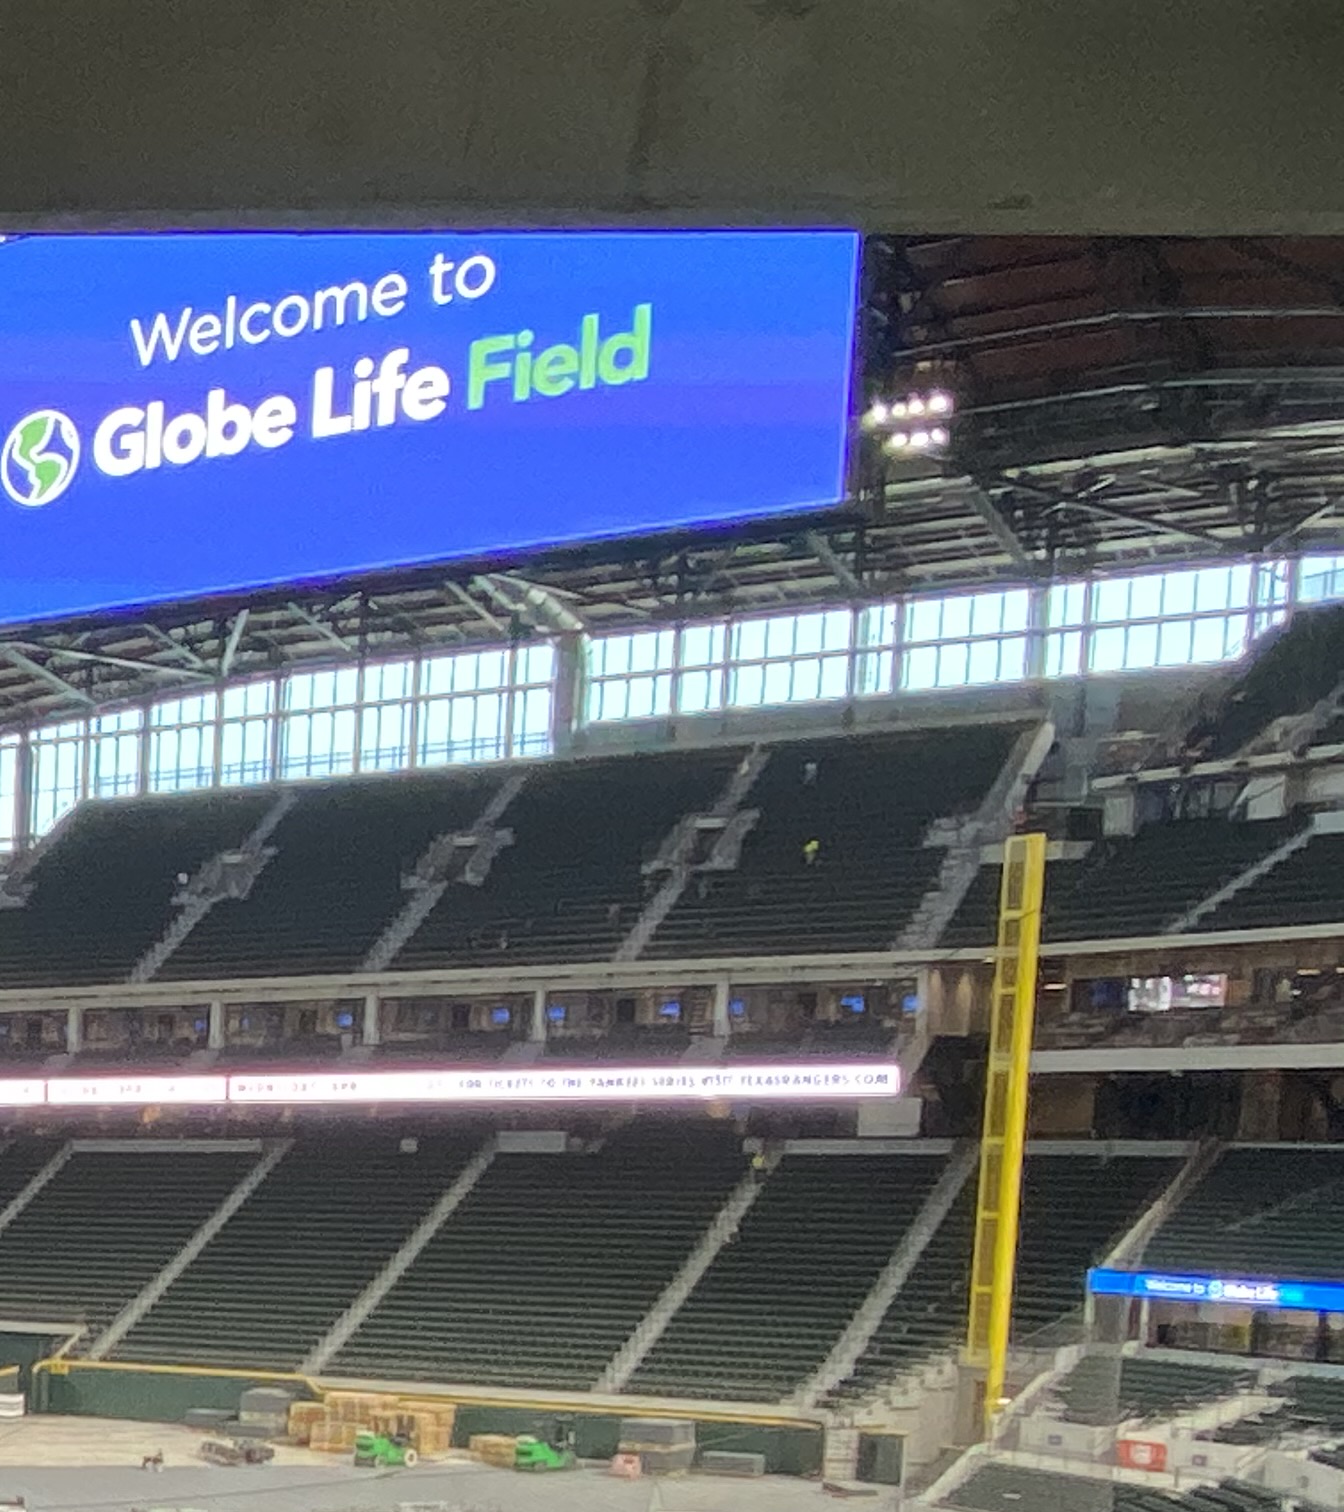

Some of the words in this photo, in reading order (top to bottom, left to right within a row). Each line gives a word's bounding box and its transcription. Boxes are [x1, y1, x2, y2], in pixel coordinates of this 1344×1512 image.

[128, 273, 410, 368] Welcome
[428, 252, 497, 306] to
[92, 386, 298, 478] Globe
[310, 346, 451, 440] Life
[467, 302, 653, 411] Field
